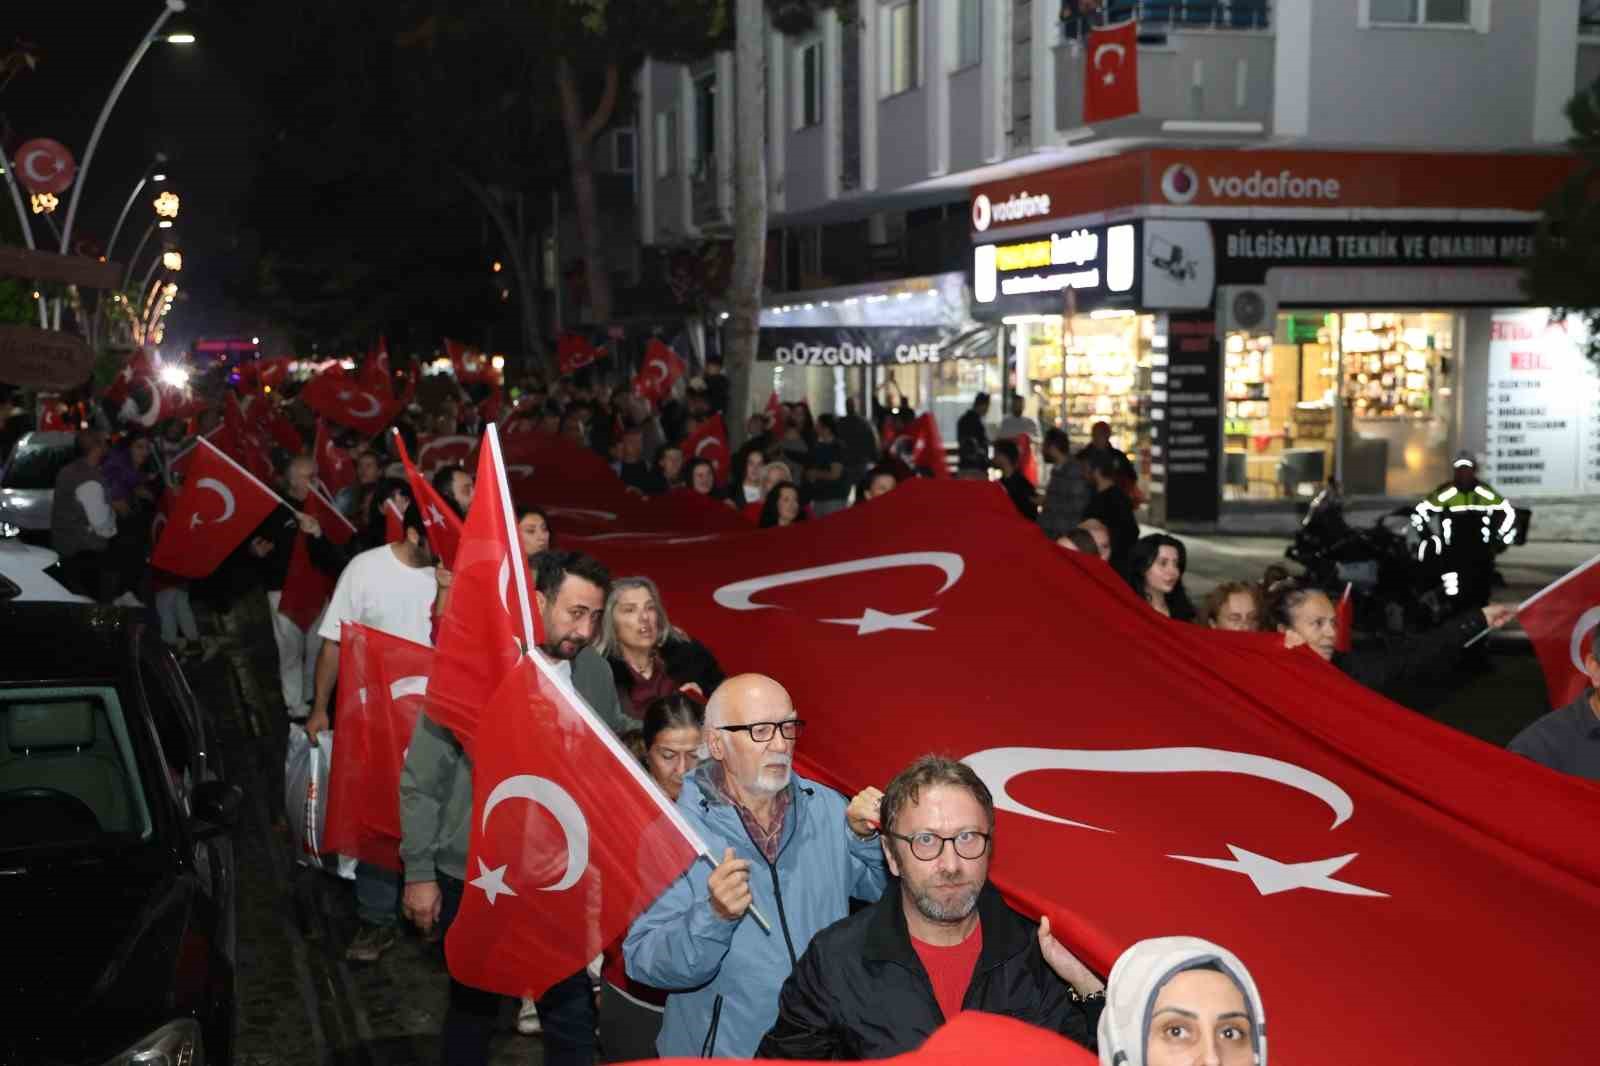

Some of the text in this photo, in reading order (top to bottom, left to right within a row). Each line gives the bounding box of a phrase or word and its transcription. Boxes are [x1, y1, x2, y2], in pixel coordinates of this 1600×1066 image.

[1208, 169, 1340, 199] vodafone
[992, 191, 1050, 222] vodafone
[1227, 229, 1331, 257] BİLGİSAYAR
[1336, 228, 1397, 258] TEKNİK
[1402, 236, 1425, 258] VE
[775, 342, 941, 366] DÜZGÜN CAFE
